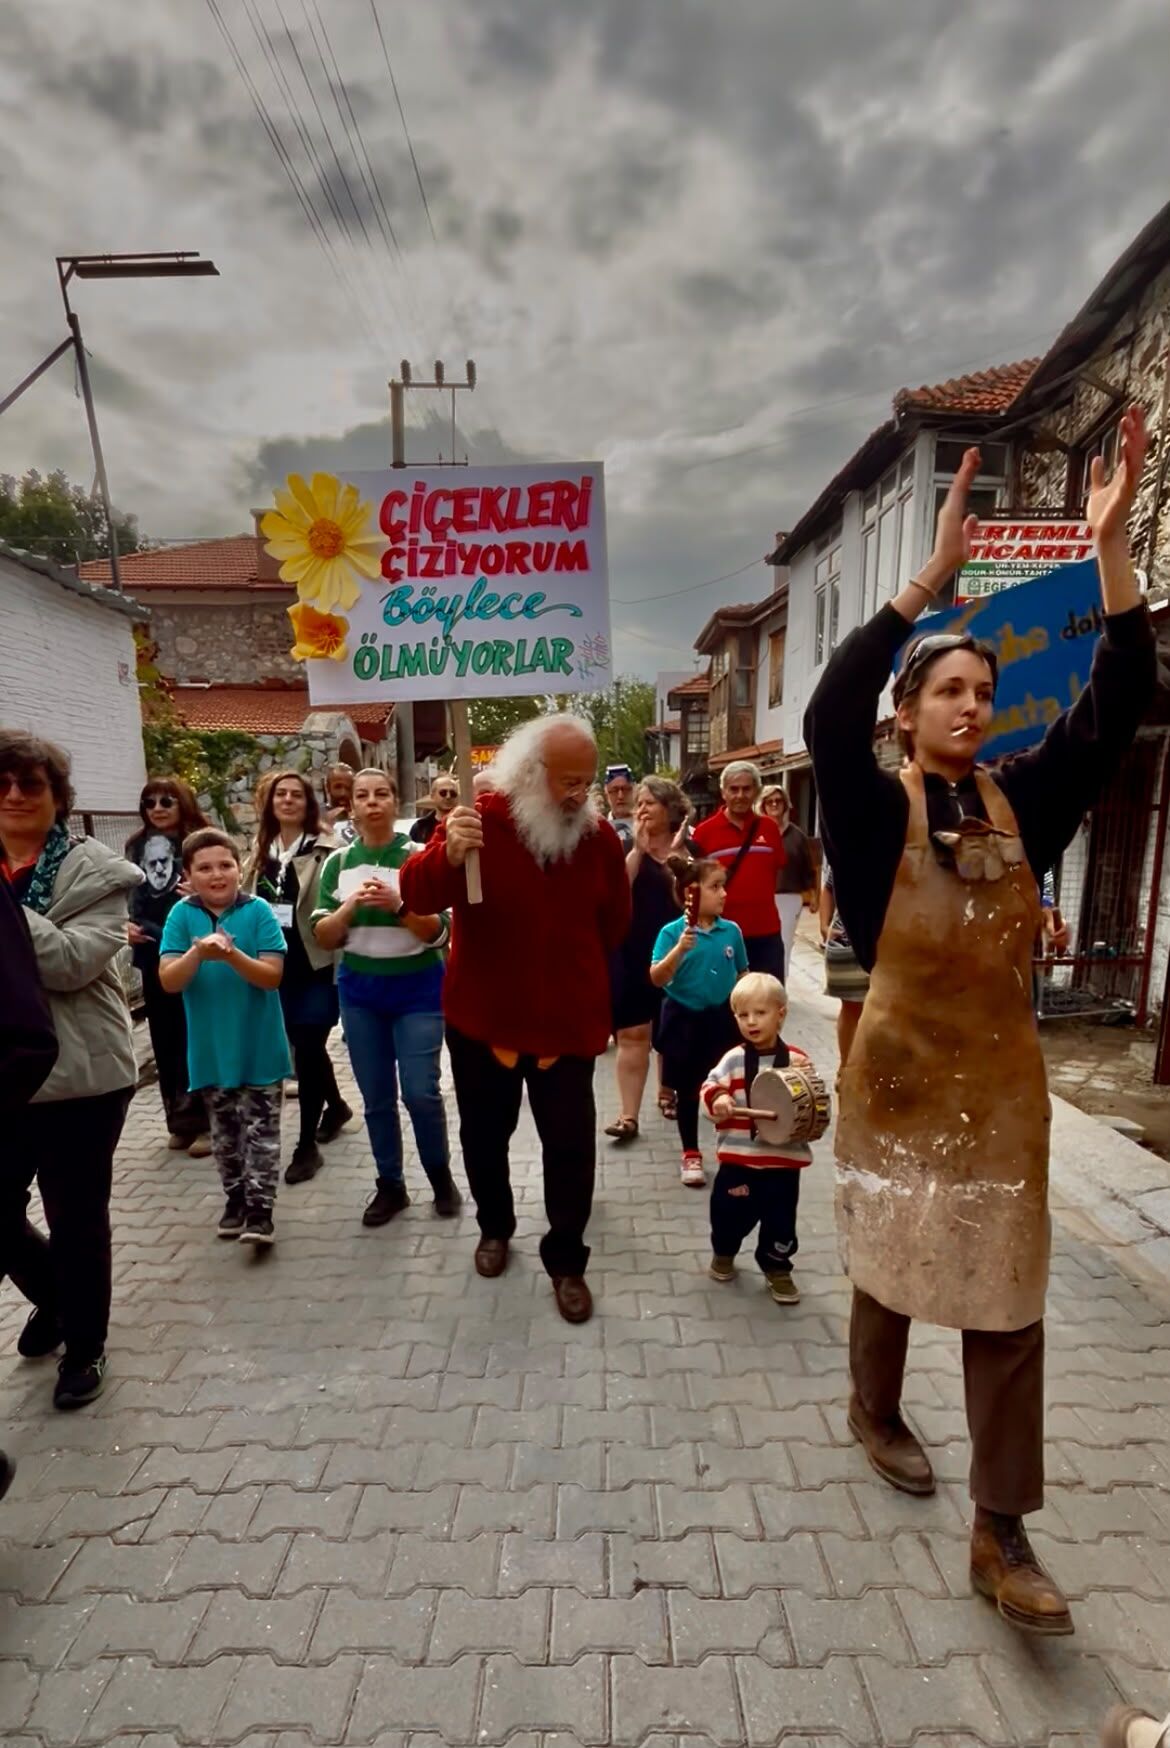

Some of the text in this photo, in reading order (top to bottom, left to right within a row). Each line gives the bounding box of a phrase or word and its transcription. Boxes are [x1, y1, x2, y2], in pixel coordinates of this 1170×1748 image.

[380, 477, 592, 545] ÇİÇEKLERİ
[380, 537, 589, 584] ÇİZİYORUM
[379, 576, 584, 636] Böylece
[353, 632, 575, 681] ÖLMÜYORLAR
